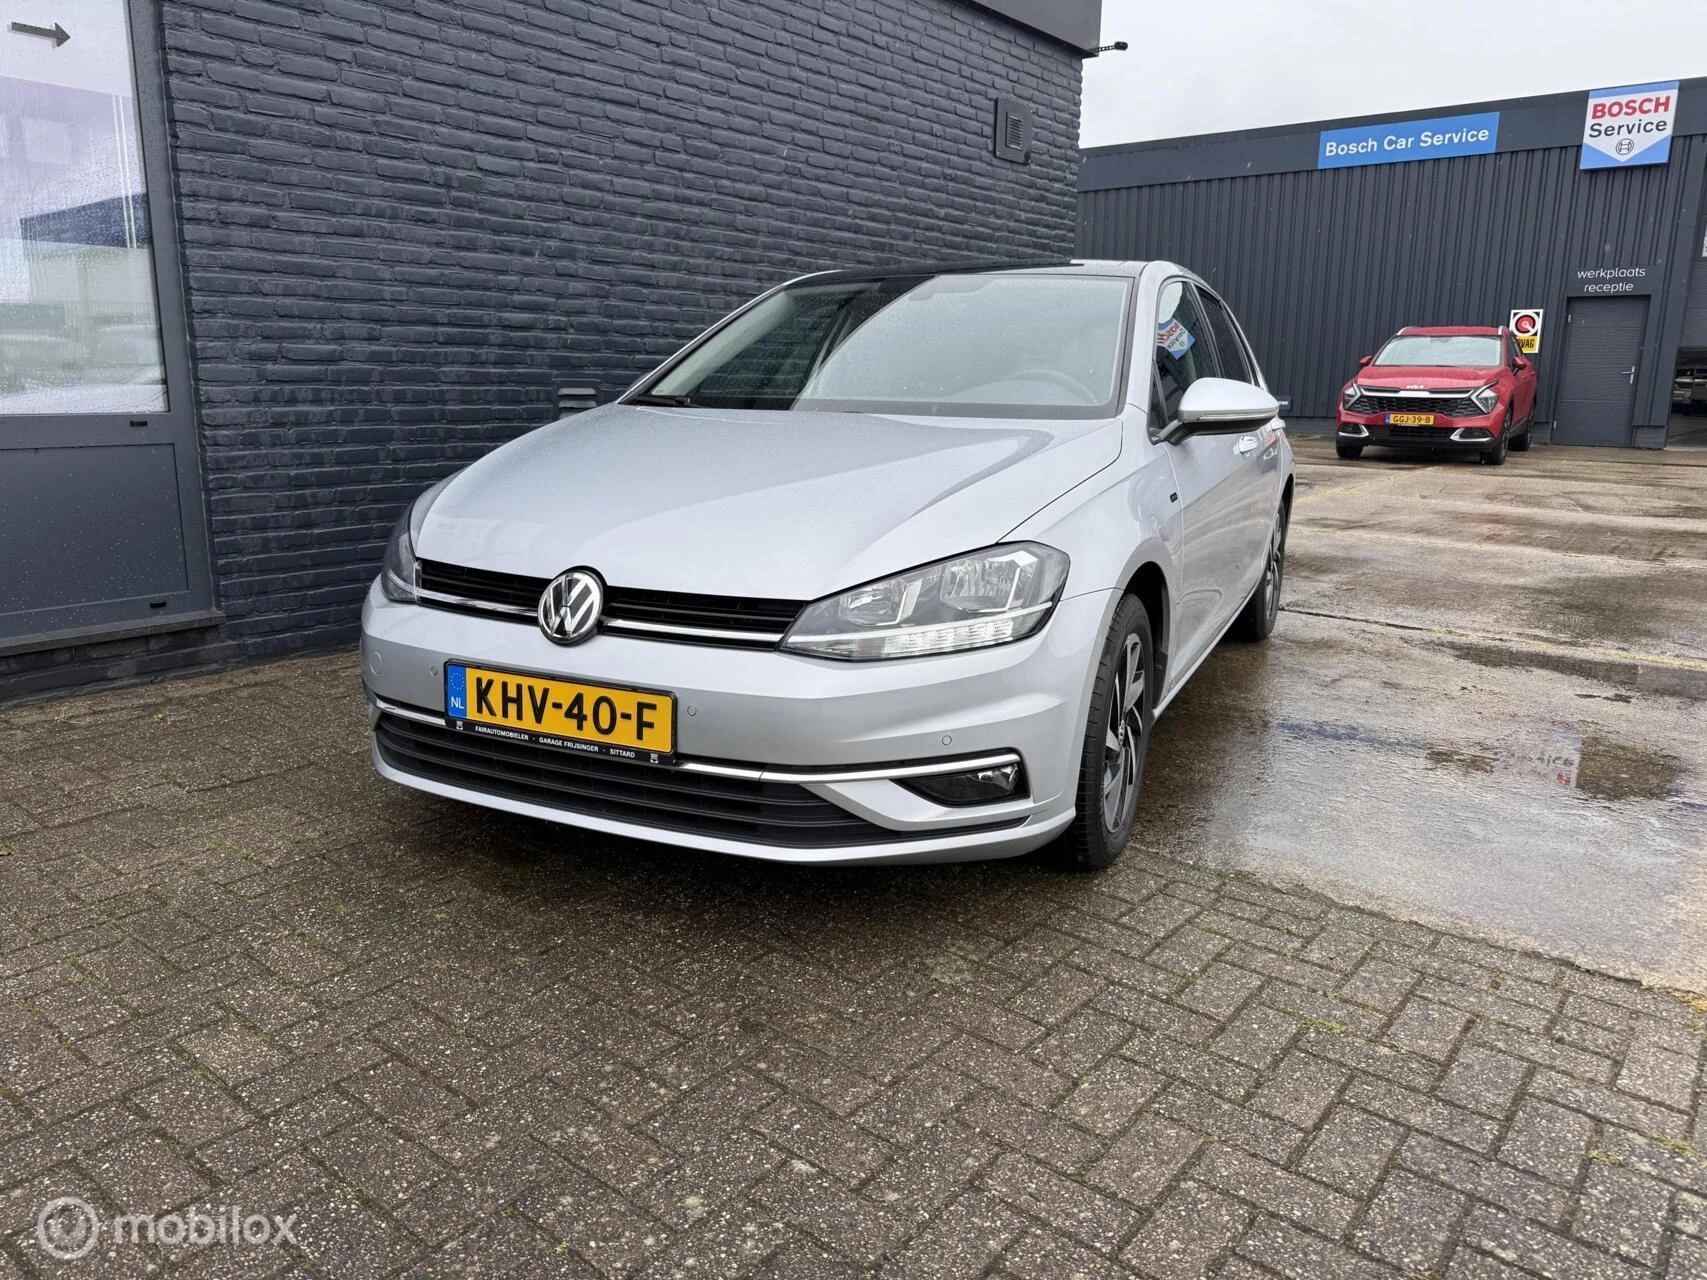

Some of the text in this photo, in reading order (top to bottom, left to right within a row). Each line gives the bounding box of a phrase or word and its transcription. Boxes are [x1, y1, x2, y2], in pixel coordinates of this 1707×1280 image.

[1591, 96, 1671, 120] BOSCH
[1588, 119, 1667, 138] Service
[1325, 128, 1489, 156] Bosch Car Service
[1577, 267, 1646, 280] werkplaats
[1583, 282, 1634, 294] receptie
[450, 695, 465, 709] NL
[475, 676, 657, 741] KHV-40-F
[475, 725, 529, 741] FAIRAUTOMOBIELEN
[539, 736, 563, 747] GARAGE
[563, 740, 599, 753] FRIJSINGER
[609, 748, 636, 758] SITTARD
